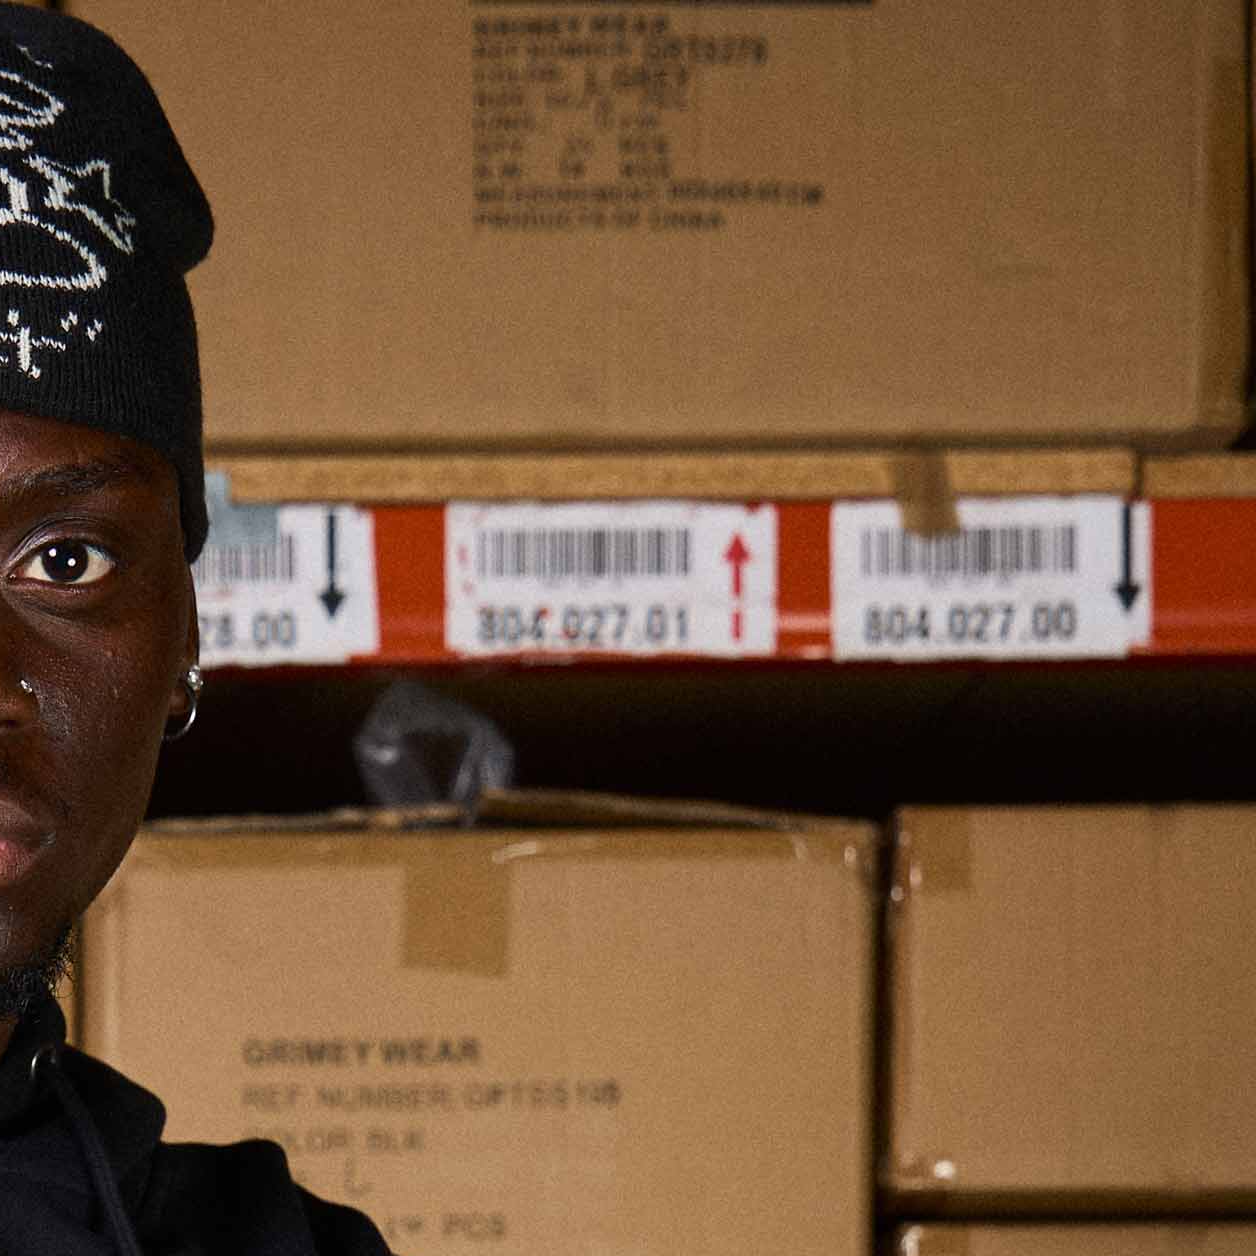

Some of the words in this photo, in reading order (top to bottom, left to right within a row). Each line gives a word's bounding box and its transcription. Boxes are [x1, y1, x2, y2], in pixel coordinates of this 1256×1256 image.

[198, 612, 297, 649] 28.00
[479, 605, 688, 643] 804.027.01
[864, 603, 1076, 644] 804.027.00
[241, 1037, 371, 1067] GRIMEY
[377, 1036, 481, 1067] WEAR
[443, 1211, 508, 1241] PCS
